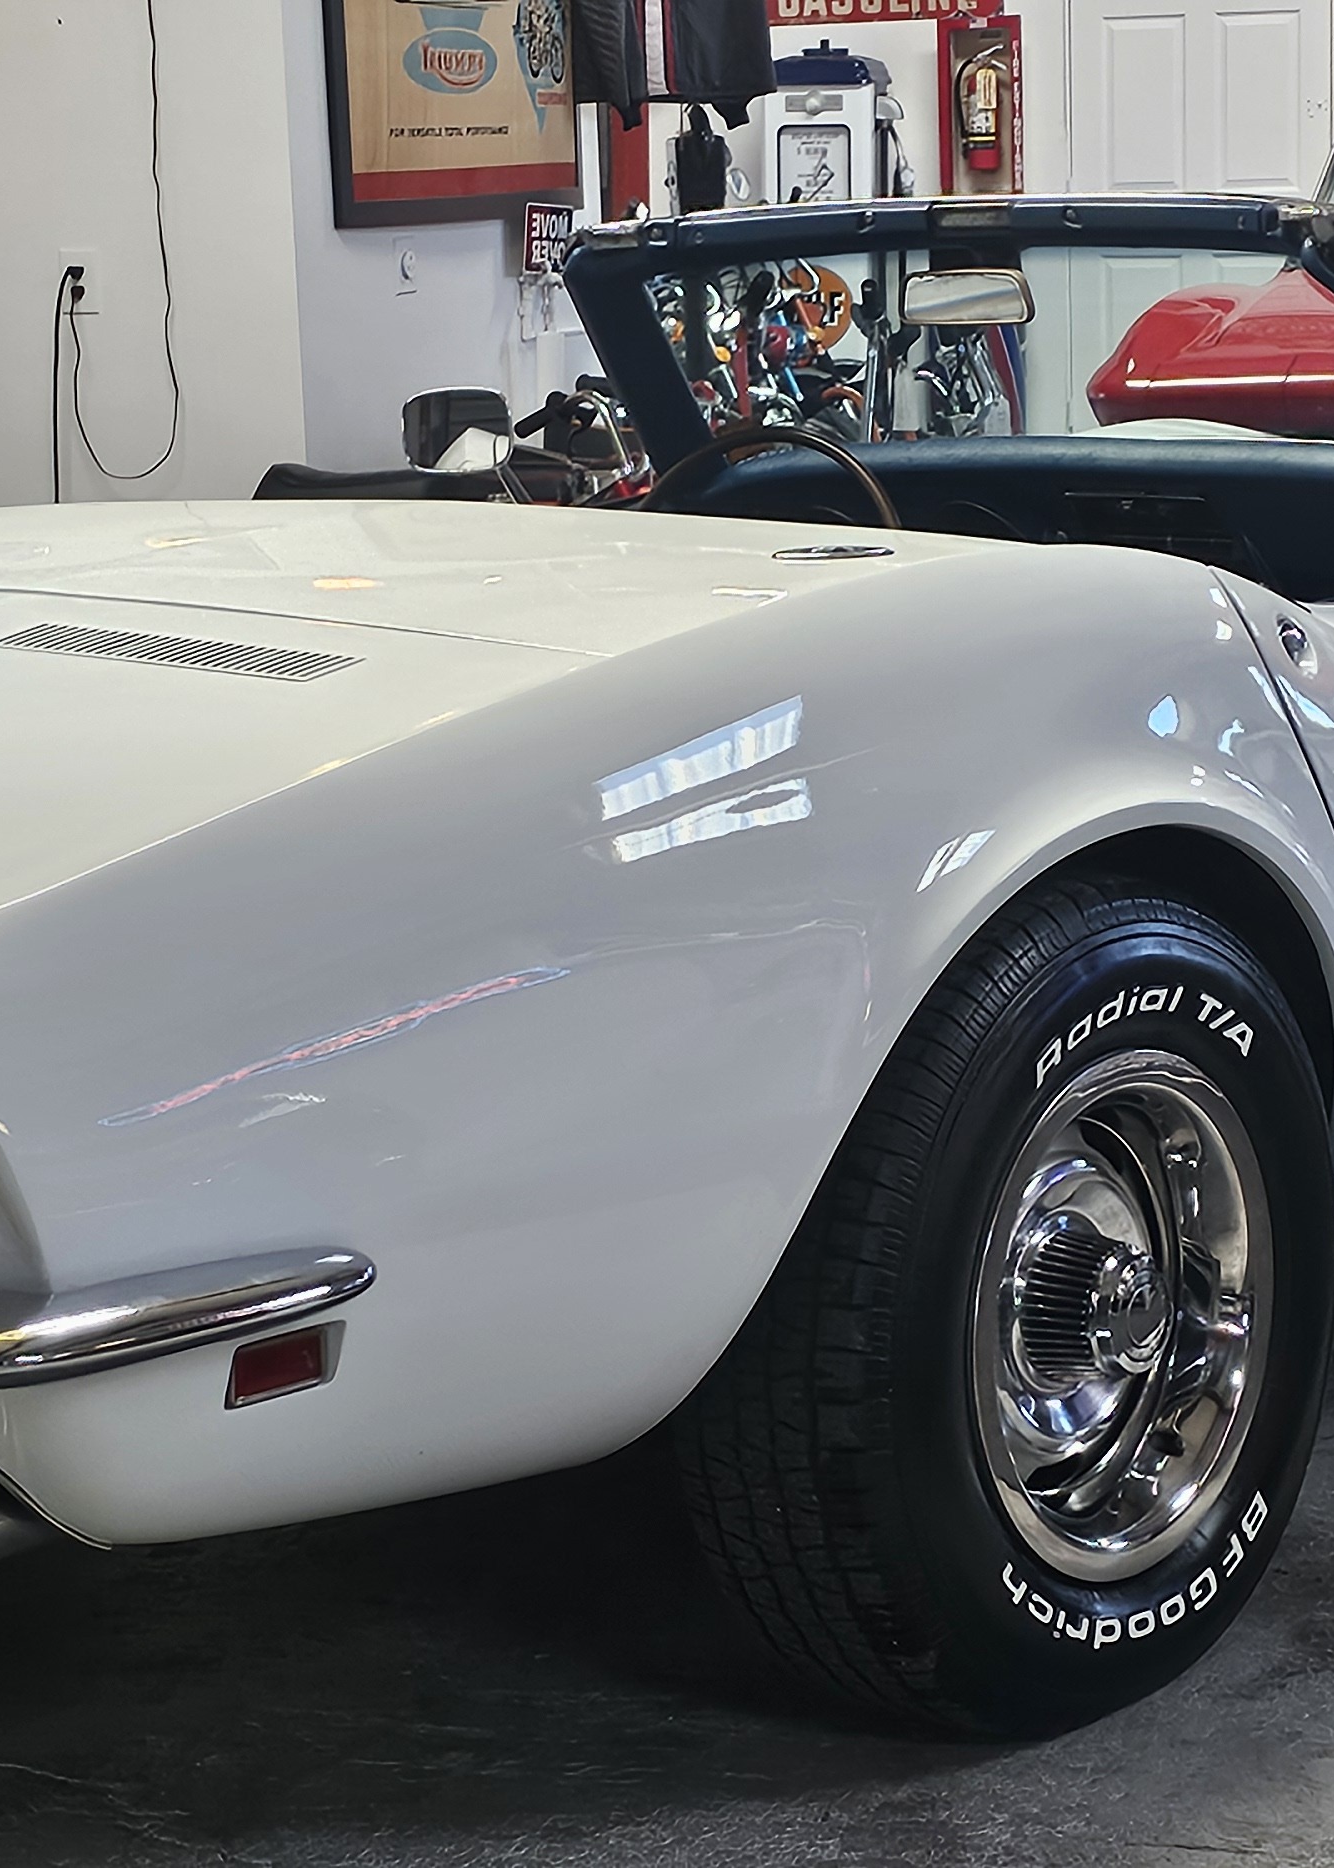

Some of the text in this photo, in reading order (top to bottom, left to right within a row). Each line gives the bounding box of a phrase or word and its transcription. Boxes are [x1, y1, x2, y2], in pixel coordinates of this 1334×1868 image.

[1035, 985, 1255, 1090] Radial T/A
[1001, 1489, 1269, 1650] BFGoodrich
